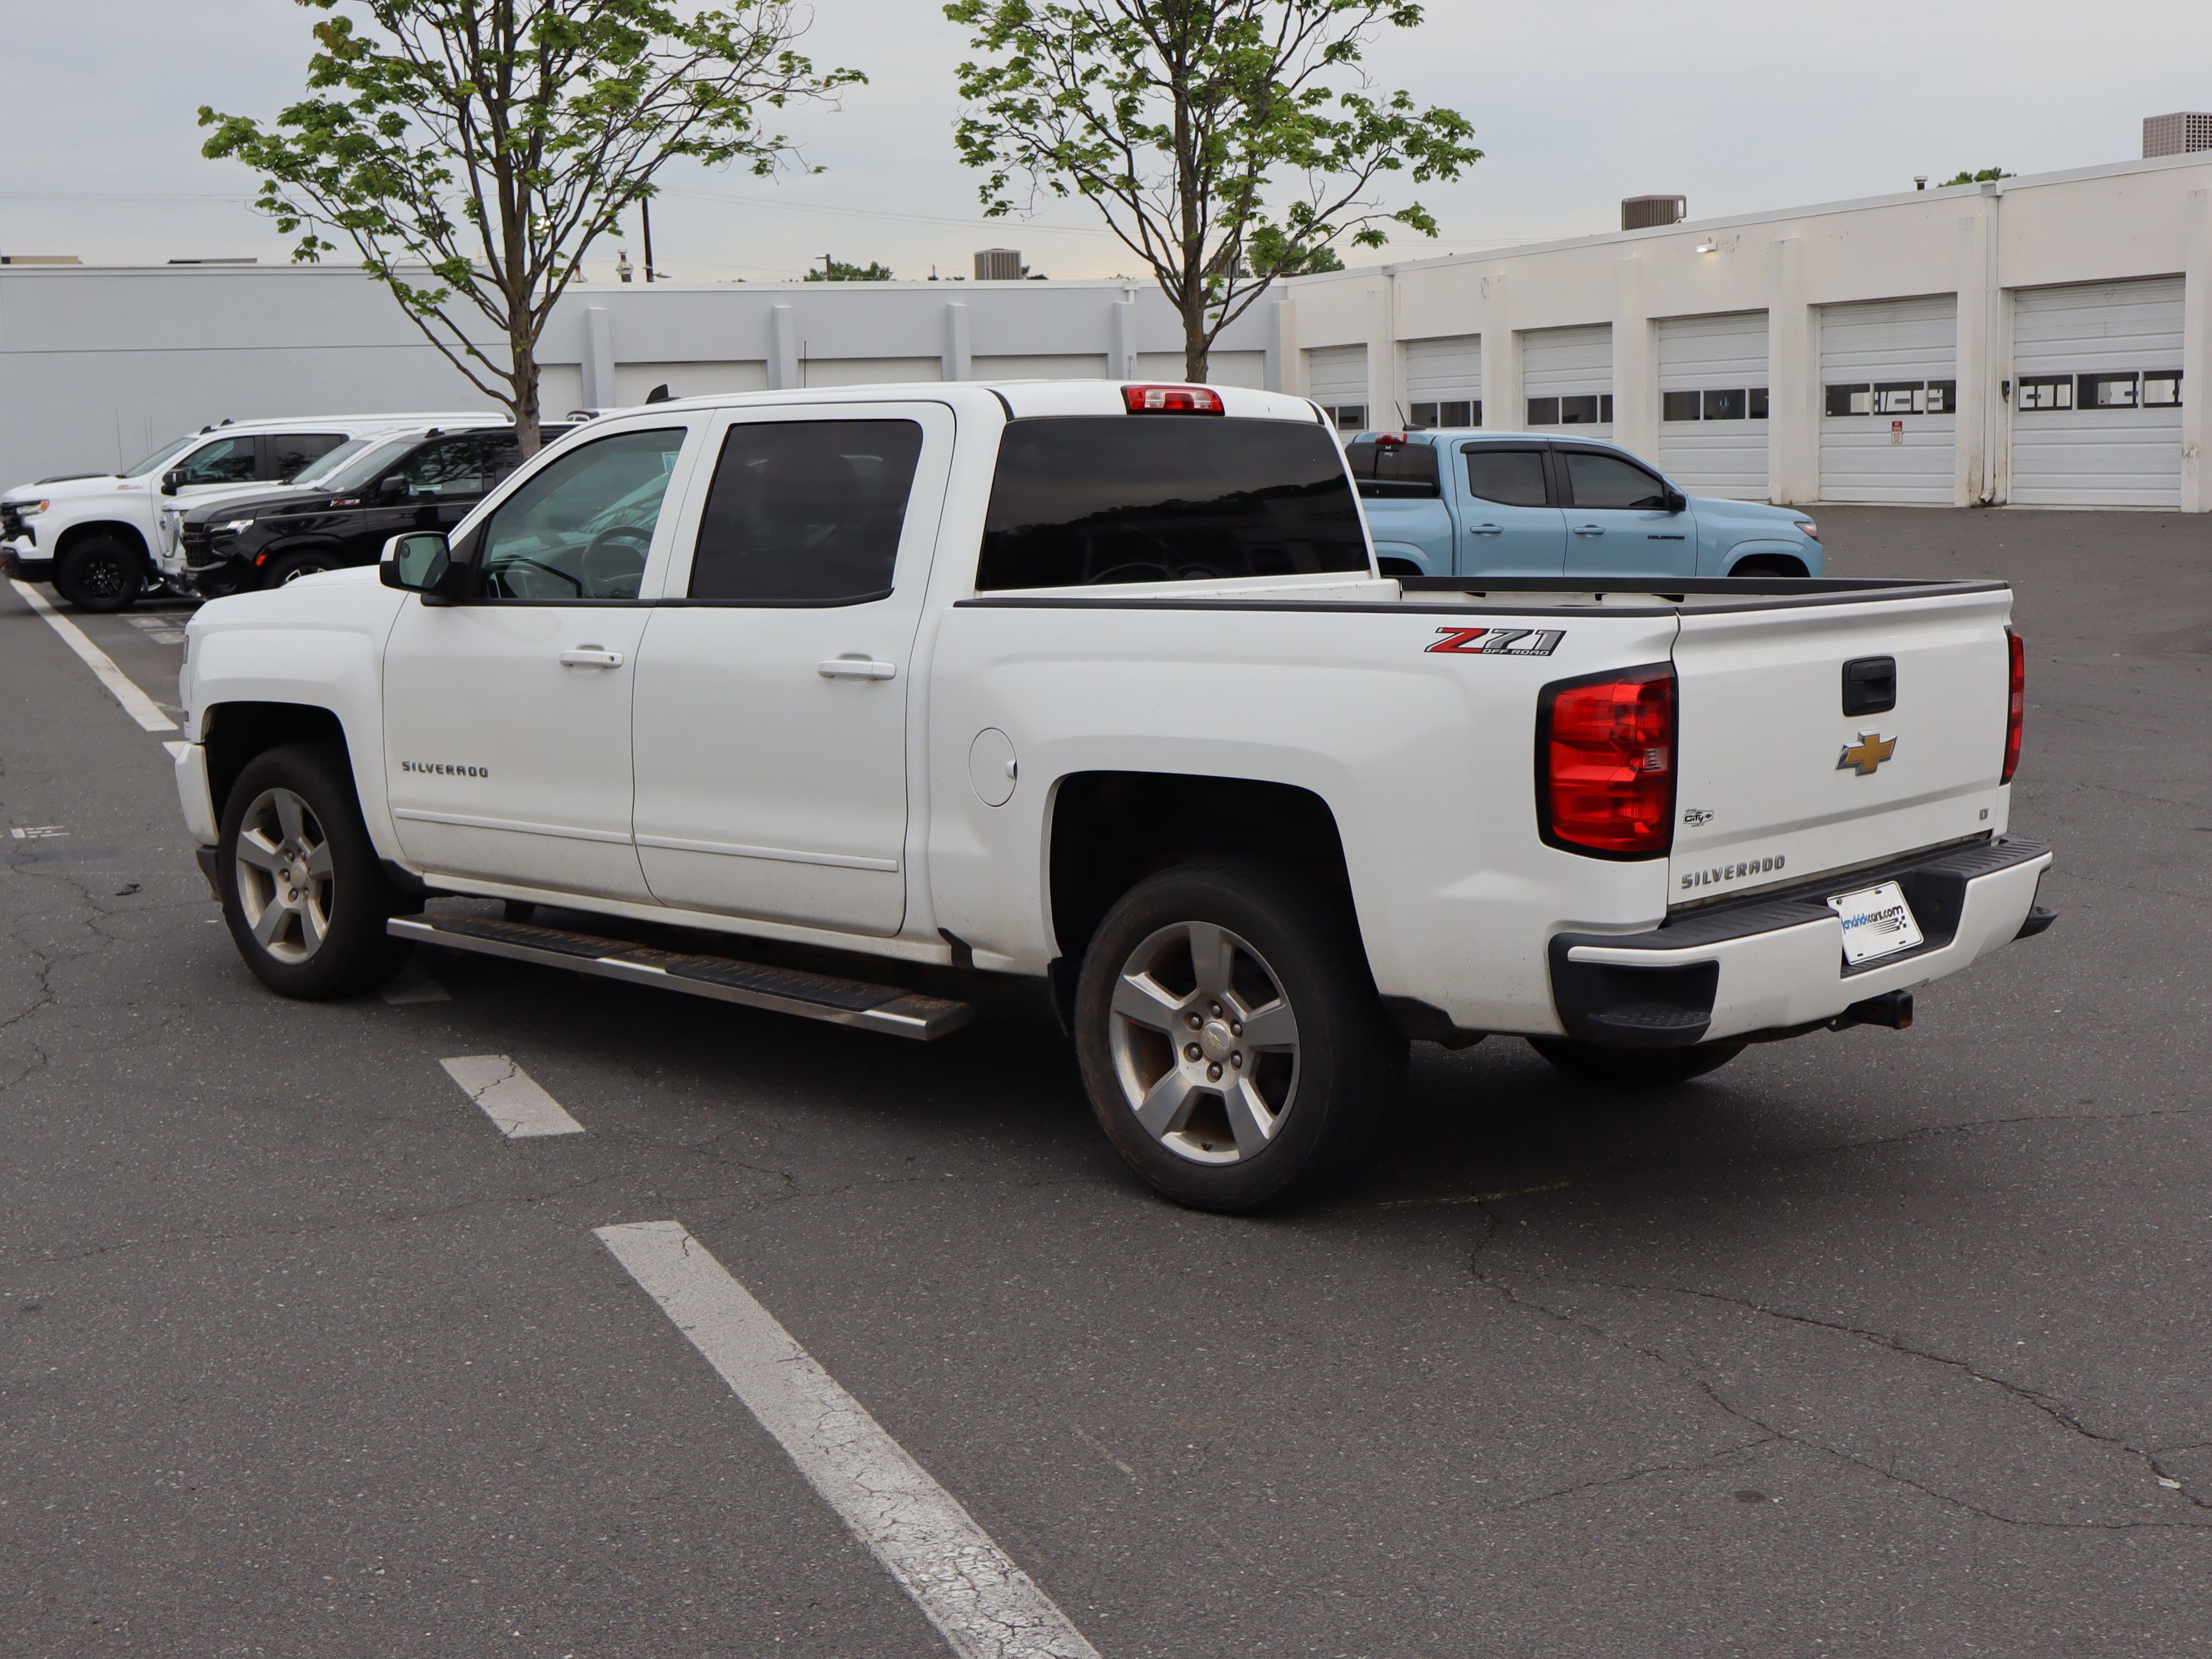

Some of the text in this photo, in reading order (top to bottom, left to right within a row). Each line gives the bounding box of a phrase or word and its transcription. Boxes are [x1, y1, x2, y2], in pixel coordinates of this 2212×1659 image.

[1423, 627, 1567, 656] Z71
[401, 761, 489, 778] SILVERADO
[1685, 812, 1704, 823] City
[1681, 854, 1786, 889] SILVERADO
